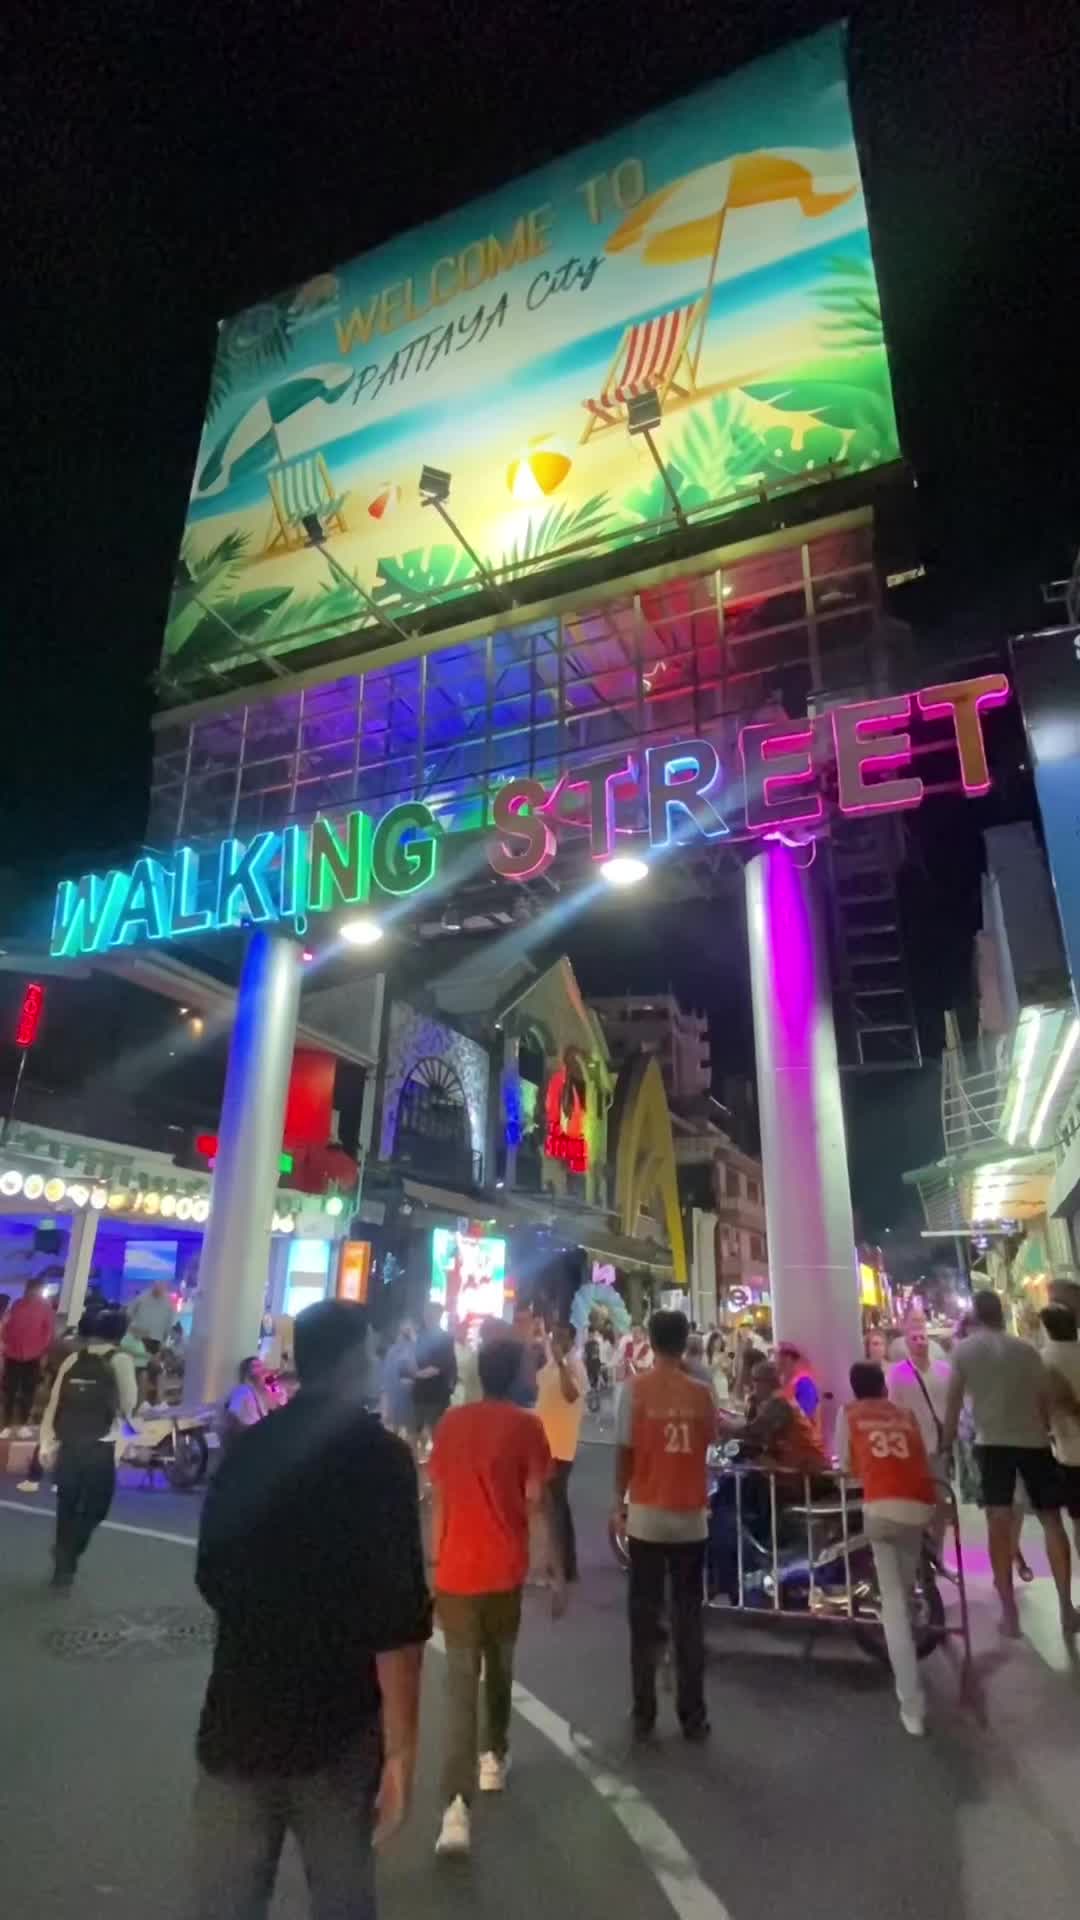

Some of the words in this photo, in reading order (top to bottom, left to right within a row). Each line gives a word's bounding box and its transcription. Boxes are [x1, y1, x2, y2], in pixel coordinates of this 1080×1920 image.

[335, 203, 553, 355] WELCOME
[575, 158, 645, 225] TO
[350, 292, 509, 407] PATTAYA
[527, 255, 606, 312] City
[50, 801, 440, 957] WALKING
[487, 672, 1010, 882] STREET
[663, 1422, 693, 1455] 21
[868, 1430, 910, 1459] 33
